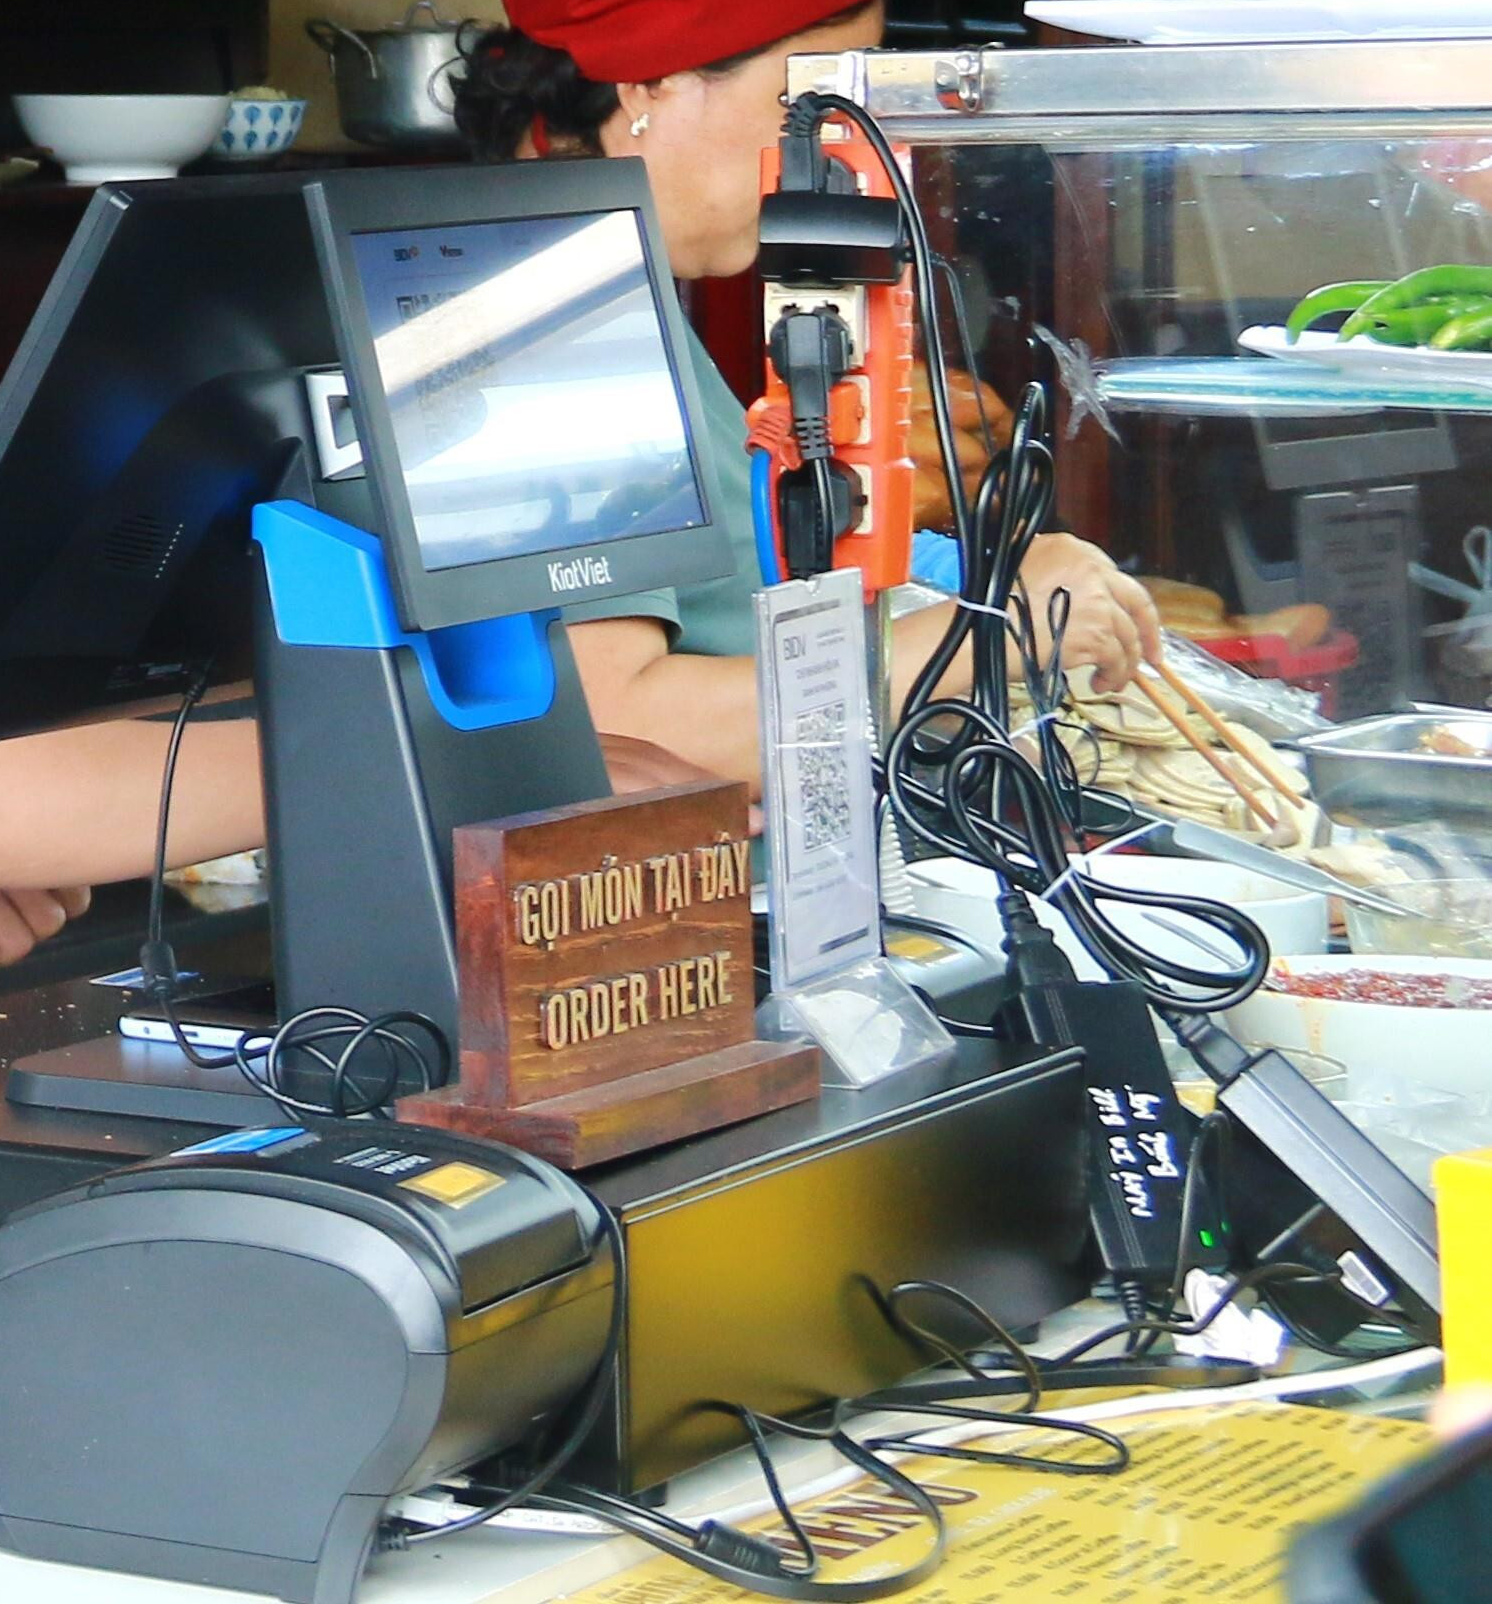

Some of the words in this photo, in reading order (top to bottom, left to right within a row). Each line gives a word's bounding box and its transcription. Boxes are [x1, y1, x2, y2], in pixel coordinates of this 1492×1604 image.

[547, 556, 612, 593] KiotViet
[518, 880, 569, 951] GỌI
[580, 855, 642, 930] MÓN
[648, 853, 692, 921] TẠI
[697, 831, 750, 903] ĐÂY
[544, 972, 648, 1051] ORDER
[659, 951, 733, 1020] HERE
